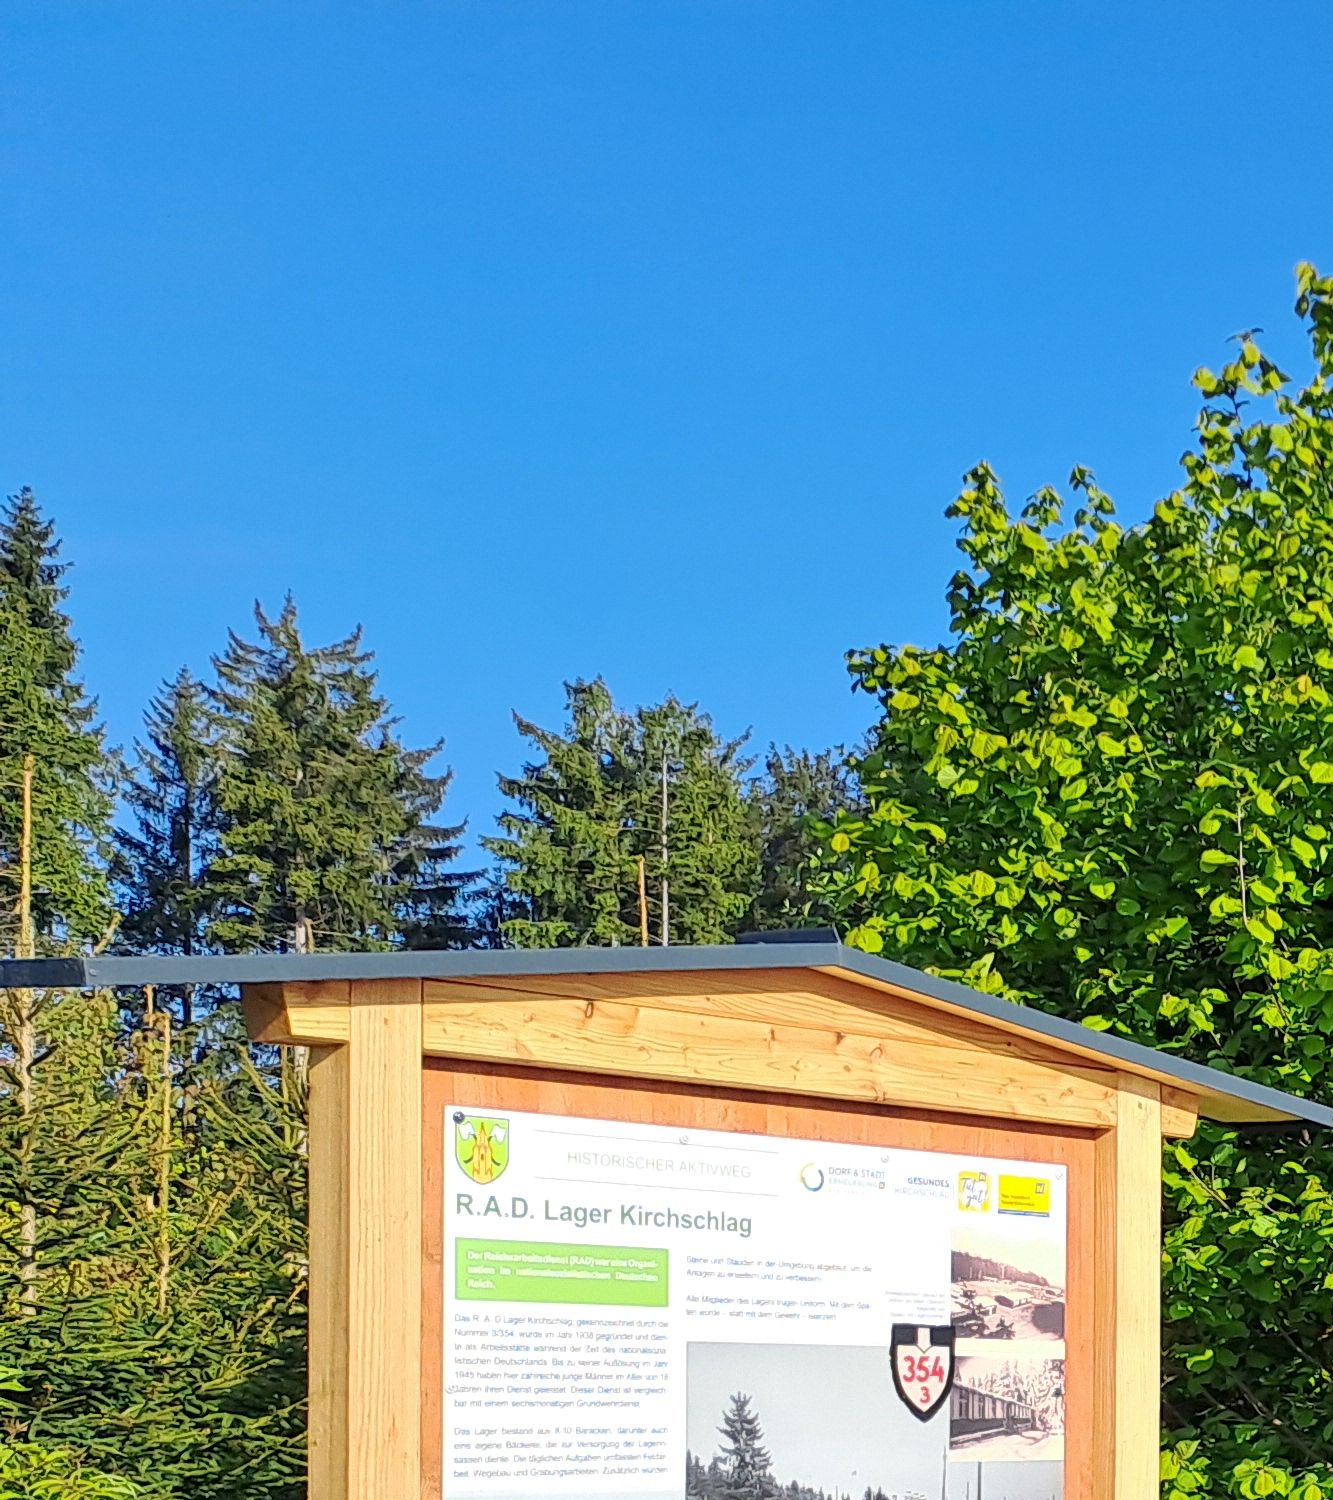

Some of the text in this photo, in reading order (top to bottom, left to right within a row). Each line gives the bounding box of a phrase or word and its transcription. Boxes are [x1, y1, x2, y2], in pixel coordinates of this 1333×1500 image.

[568, 1151, 752, 1178] HISTORISCHER AKTIVWEG
[828, 1166, 851, 1176] DORF
[861, 1169, 885, 1179] STADT
[907, 1177, 950, 1188] GESUNDES
[456, 1193, 753, 1238] R.A.D. Lager Kirchschlag
[902, 1355, 945, 1383] 354
[919, 1385, 931, 1404] 3
